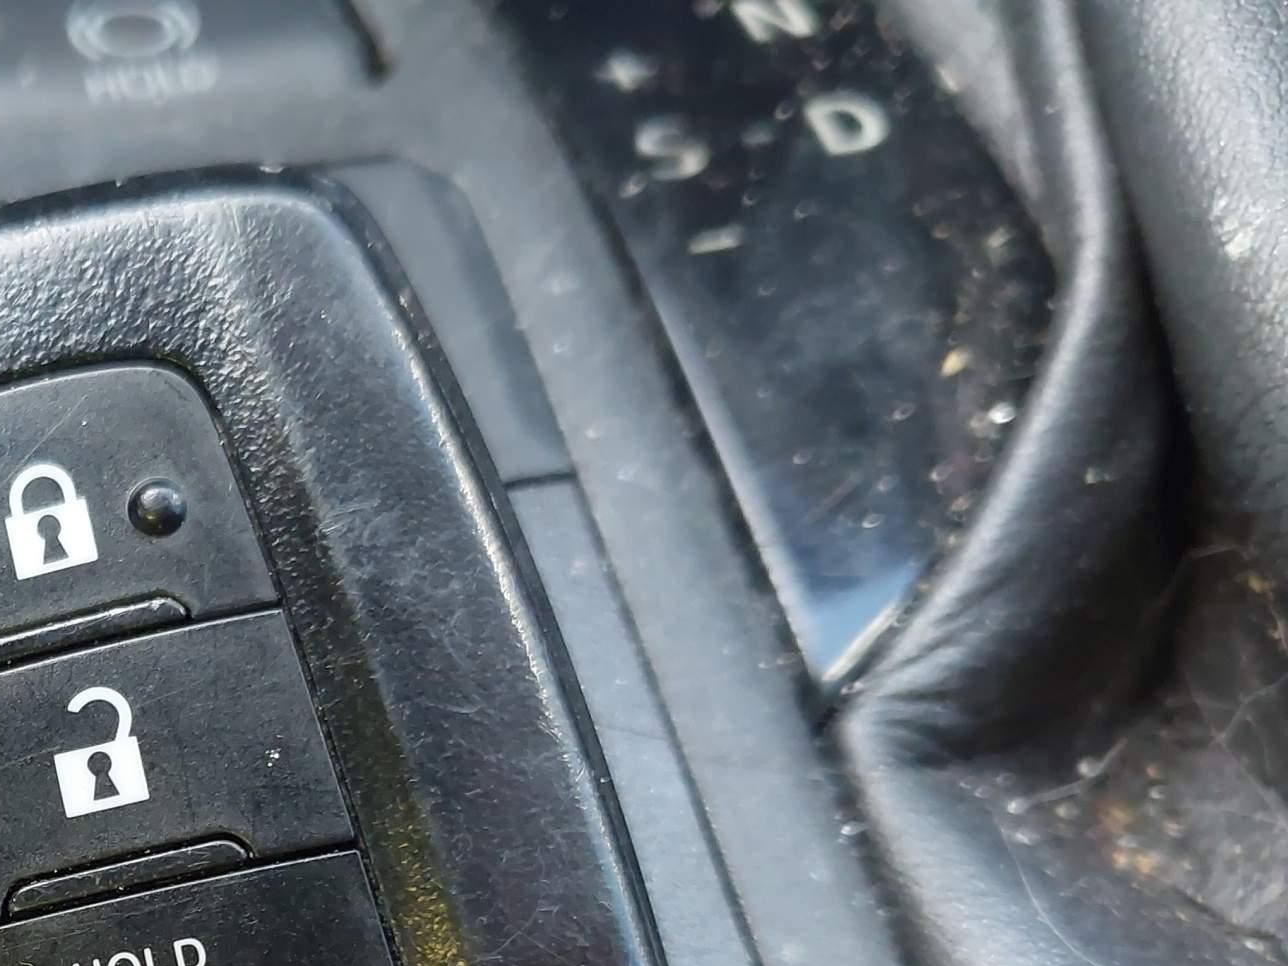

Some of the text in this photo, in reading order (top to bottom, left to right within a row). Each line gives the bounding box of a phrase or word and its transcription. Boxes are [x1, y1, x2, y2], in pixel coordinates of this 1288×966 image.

[731, 0, 815, 43] N
[634, 115, 710, 181] S
[804, 89, 889, 156] D
